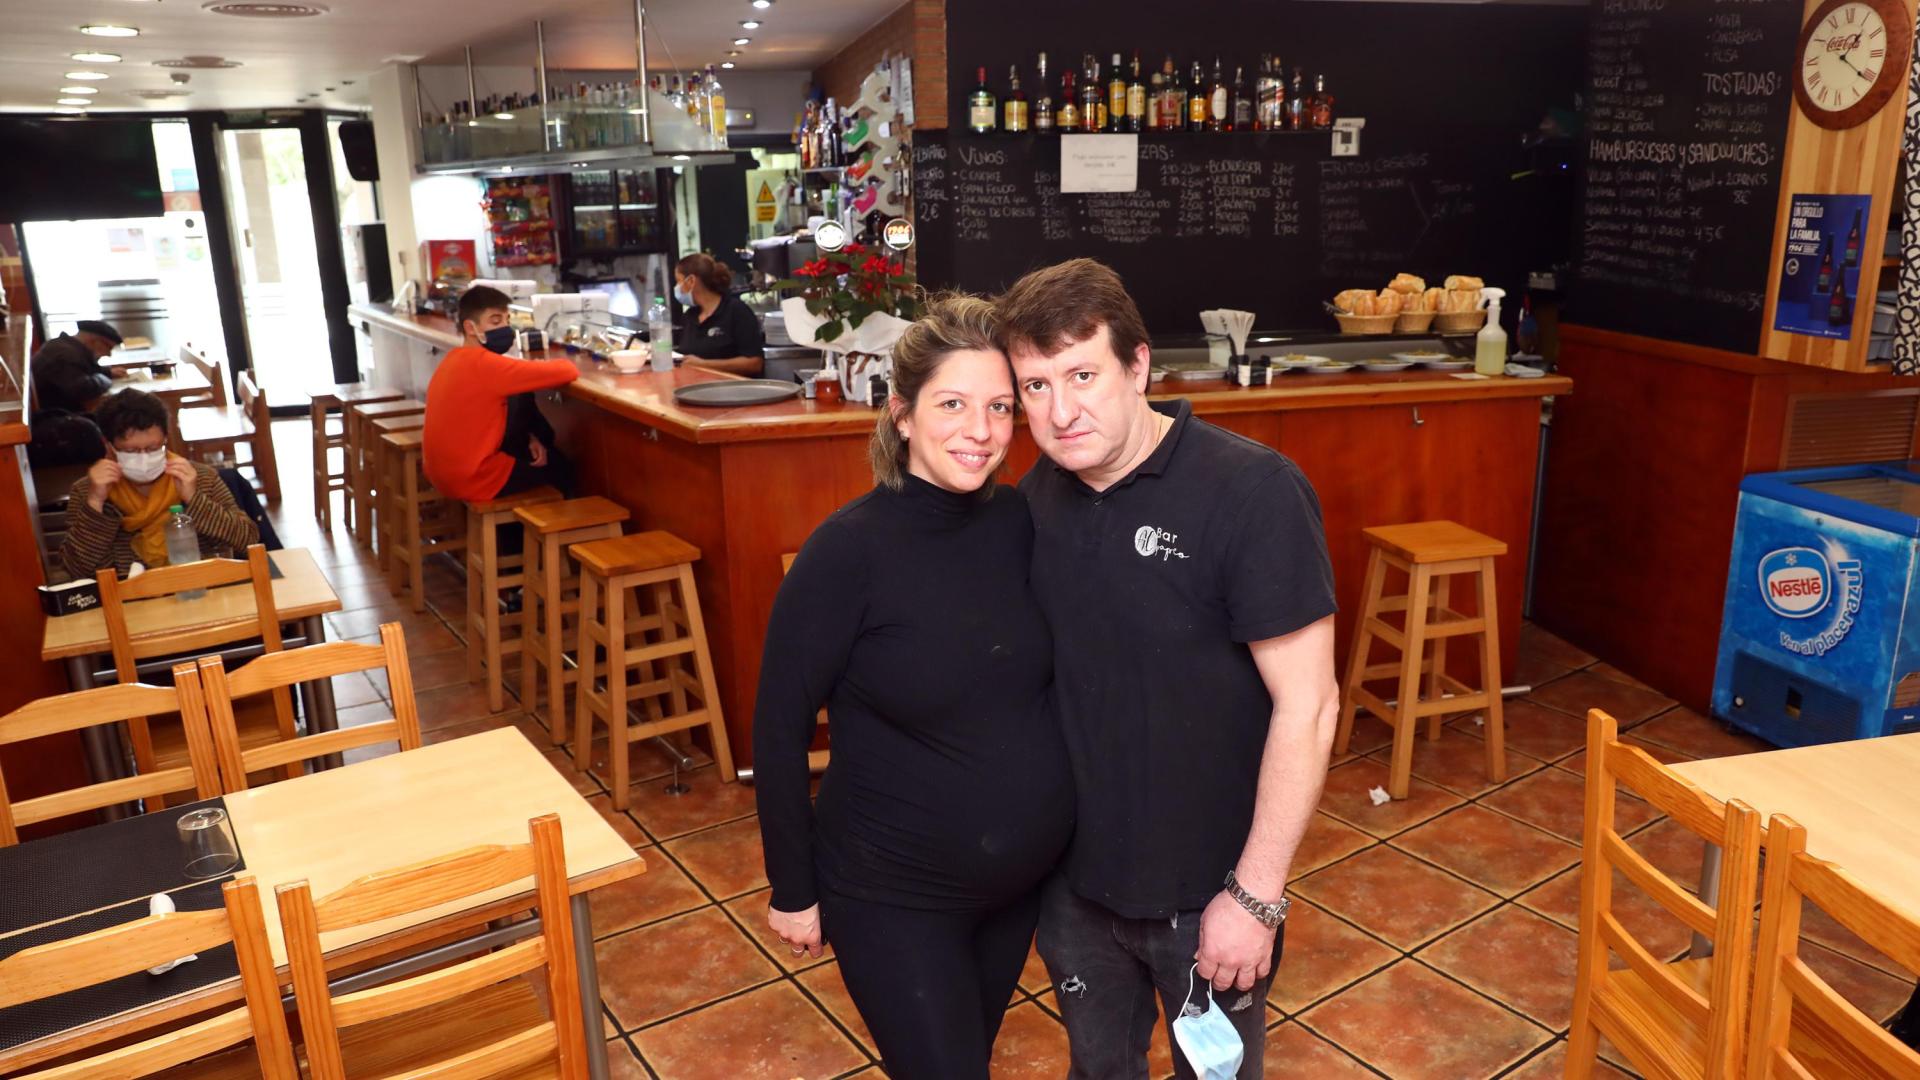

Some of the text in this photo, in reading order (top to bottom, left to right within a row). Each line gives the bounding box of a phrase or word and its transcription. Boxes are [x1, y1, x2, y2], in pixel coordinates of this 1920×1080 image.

[1702, 71, 1782, 97] TOSTADAS:
[1589, 138, 1676, 164] HAMBURGUESAS
[1156, 527, 1178, 544] Bar
[1780, 559, 1863, 657] Ven al placer azul
